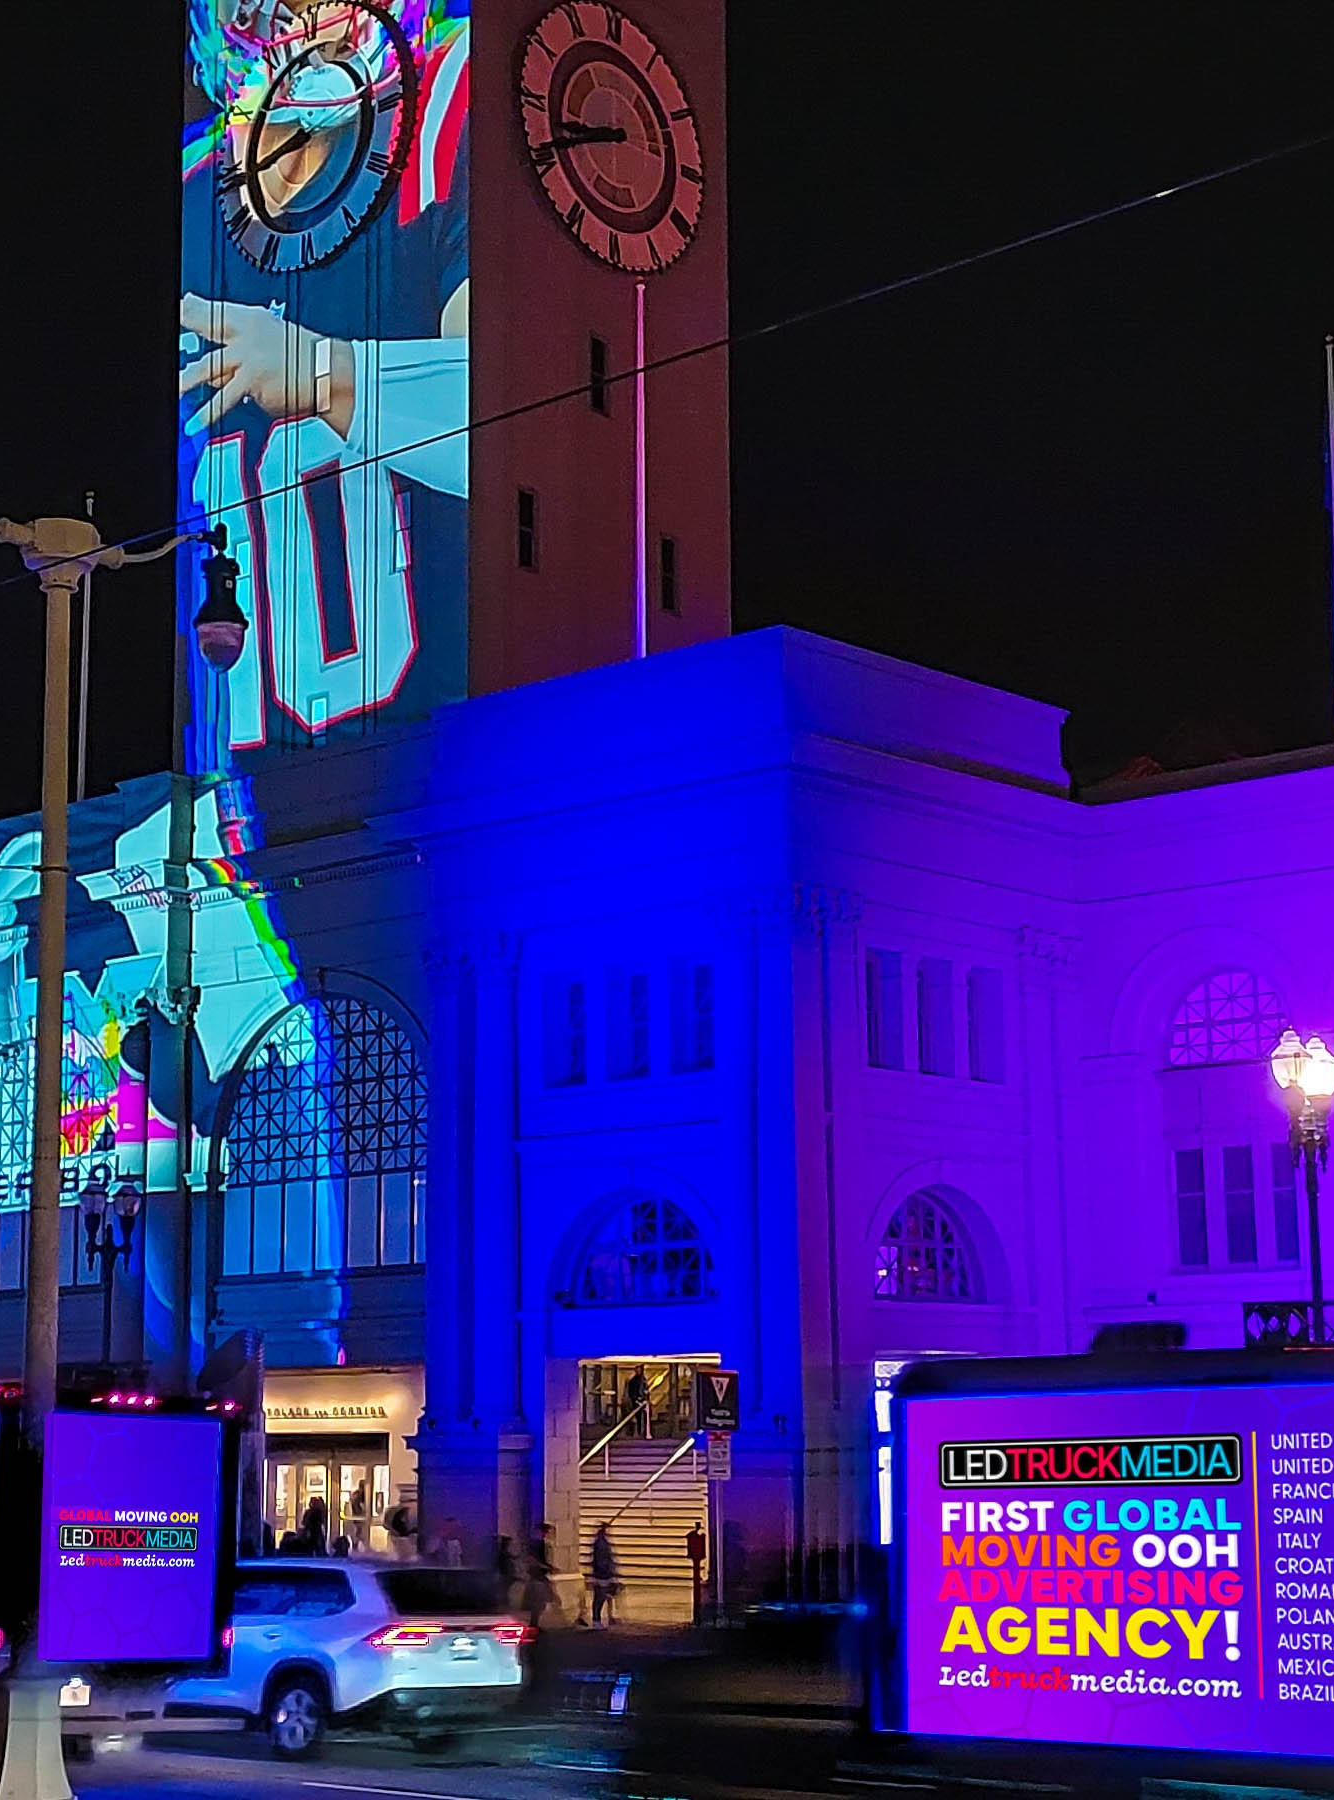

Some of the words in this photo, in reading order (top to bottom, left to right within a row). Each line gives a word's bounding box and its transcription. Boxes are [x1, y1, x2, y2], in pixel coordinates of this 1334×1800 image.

[193, 415, 419, 750] 10
[1272, 1431, 1332, 1450] UNITED
[948, 1443, 1233, 1482] LEDTRUCKMEDIA
[1272, 1457, 1334, 1474] UNITED
[60, 1510, 111, 1522] GLOBAL
[115, 1511, 167, 1523] MOVING
[170, 1512, 198, 1523] OOH
[941, 1501, 1054, 1533] FIRST
[1062, 1498, 1242, 1532] GLOBAL
[1273, 1507, 1323, 1525] SPAIN
[63, 1529, 194, 1548] LEDTRUCKMEDIA
[942, 1535, 1121, 1567] MOVING
[1132, 1534, 1238, 1569] OOH
[1278, 1533, 1321, 1550] ITALY
[938, 1569, 1243, 1606] ADVERTISING
[940, 1606, 1239, 1662] AGENCY!
[939, 1665, 1241, 1699] Ledtruckmedia.com
